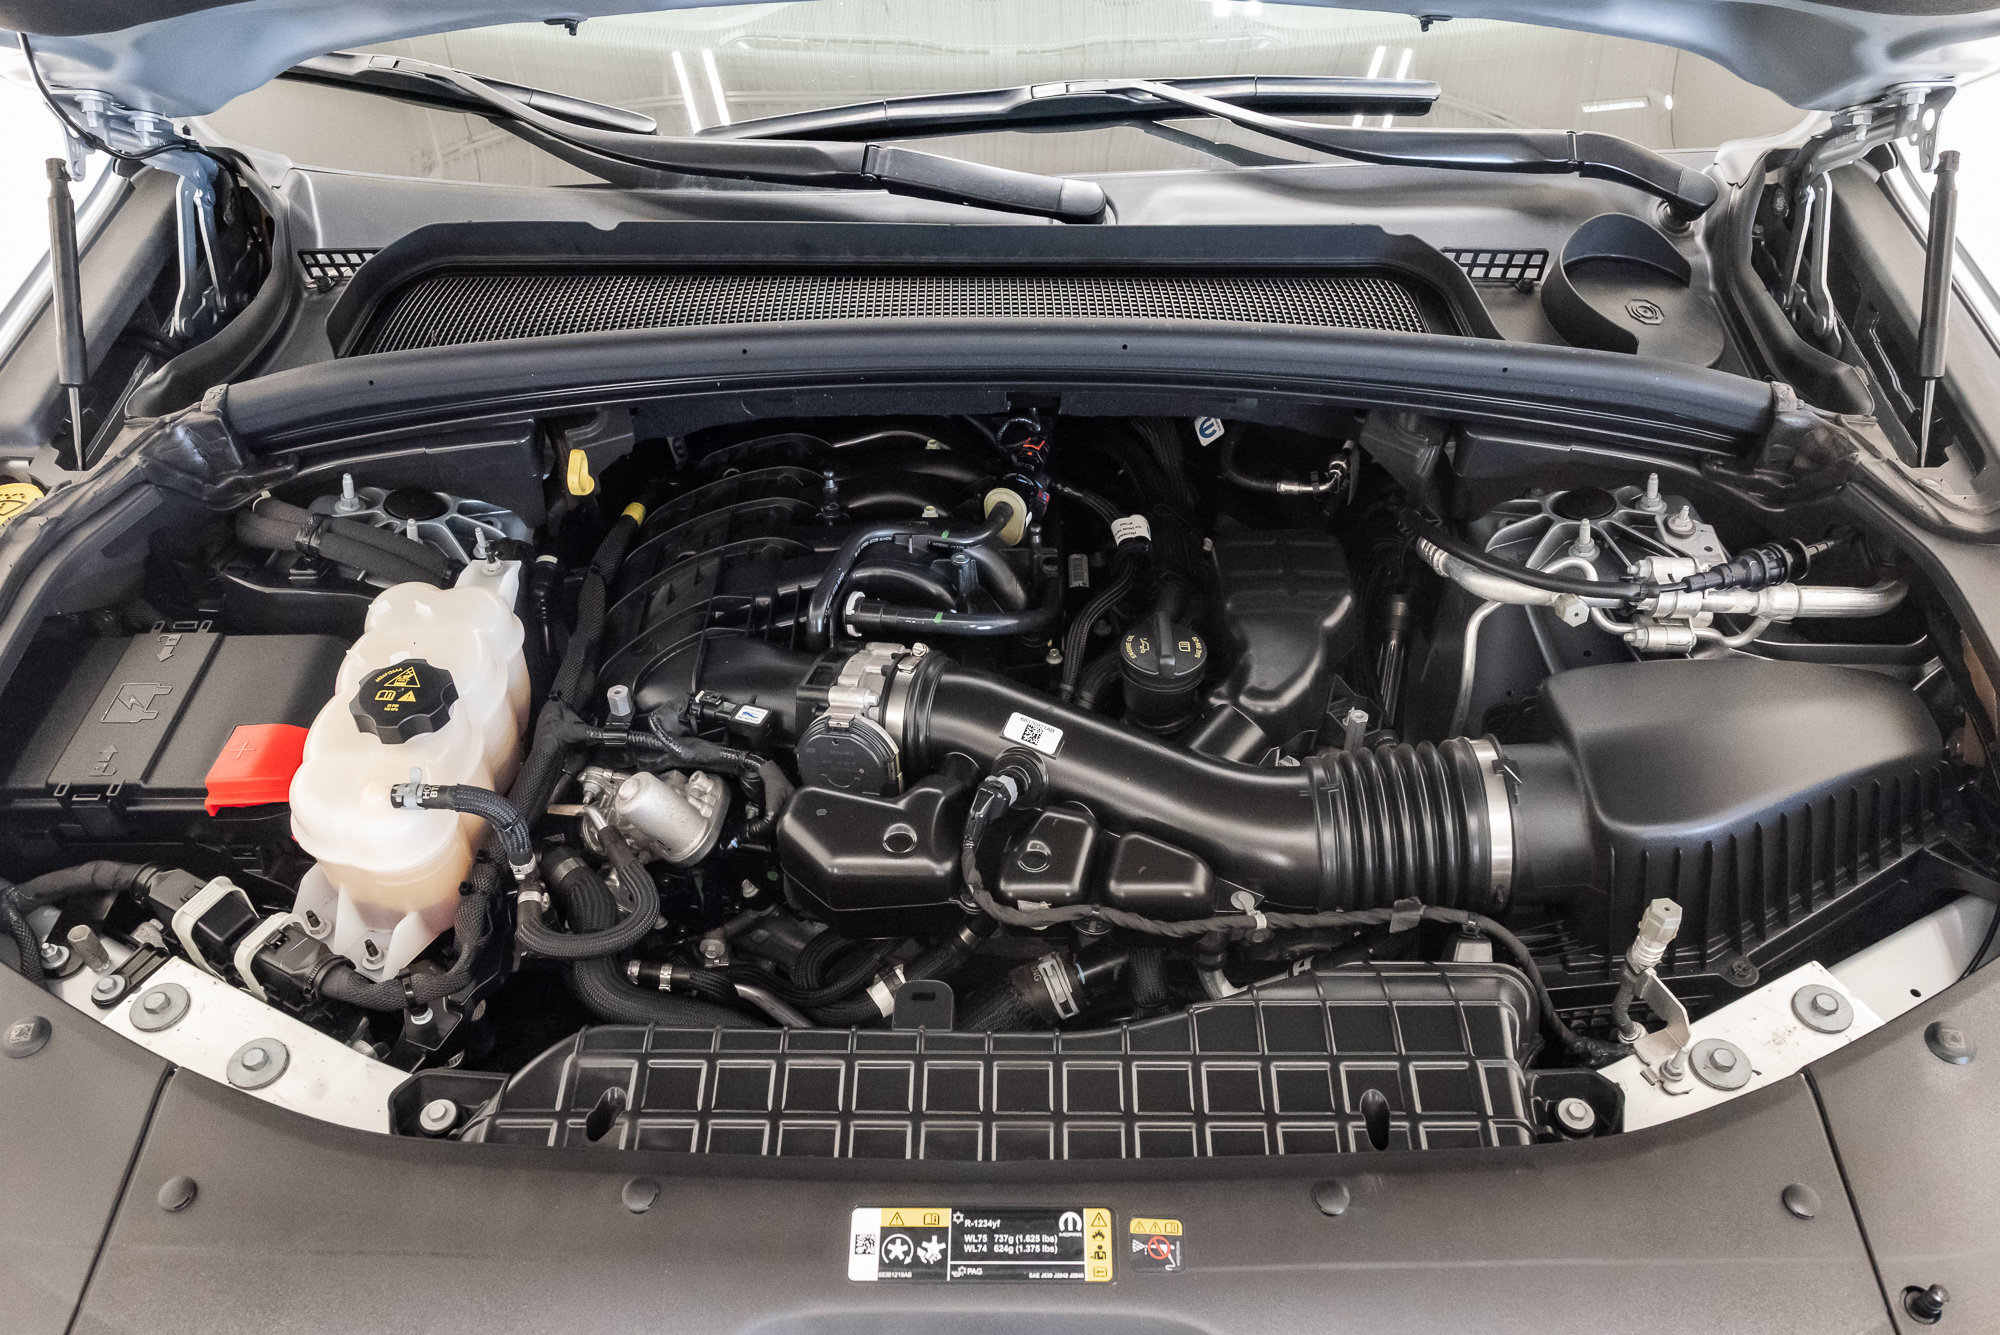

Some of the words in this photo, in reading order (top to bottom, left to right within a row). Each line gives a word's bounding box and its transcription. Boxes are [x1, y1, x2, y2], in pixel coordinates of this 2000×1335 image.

[1125, 642, 1137, 659] ENGINE
[1194, 648, 1203, 659] SAE
[964, 1219, 1001, 1229] R-1234yf
[964, 1234, 988, 1243] WL75
[993, 1234, 1014, 1244] 737g
[1015, 1234, 1040, 1244] (1.625
[1041, 1234, 1058, 1244] lbs)
[963, 1244, 988, 1253] WL74
[993, 1244, 1014, 1254] 624g
[1015, 1244, 1040, 1254] (1.375
[1041, 1244, 1058, 1254] lbs)
[966, 1268, 983, 1276] PAG
